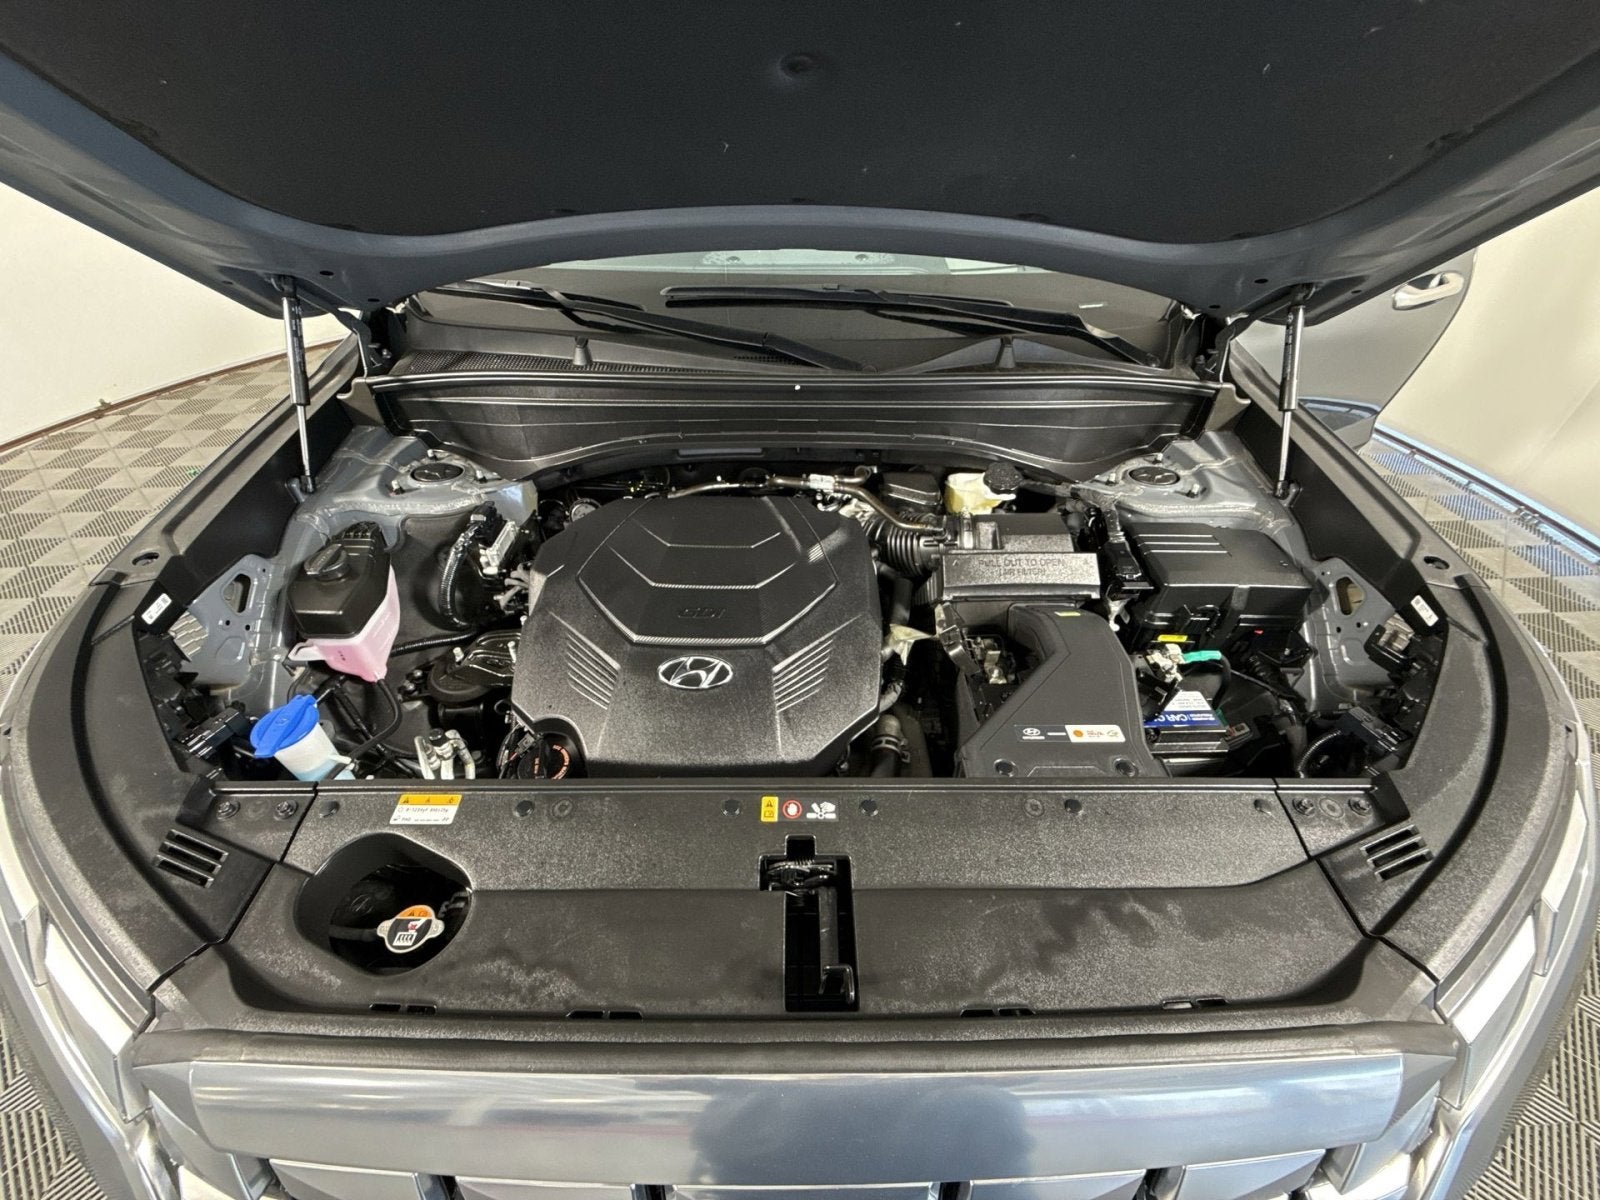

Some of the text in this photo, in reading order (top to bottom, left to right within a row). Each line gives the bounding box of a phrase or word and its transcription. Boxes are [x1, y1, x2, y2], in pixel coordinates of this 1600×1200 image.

[979, 558, 1065, 567] PULL OUT TO OPEN
